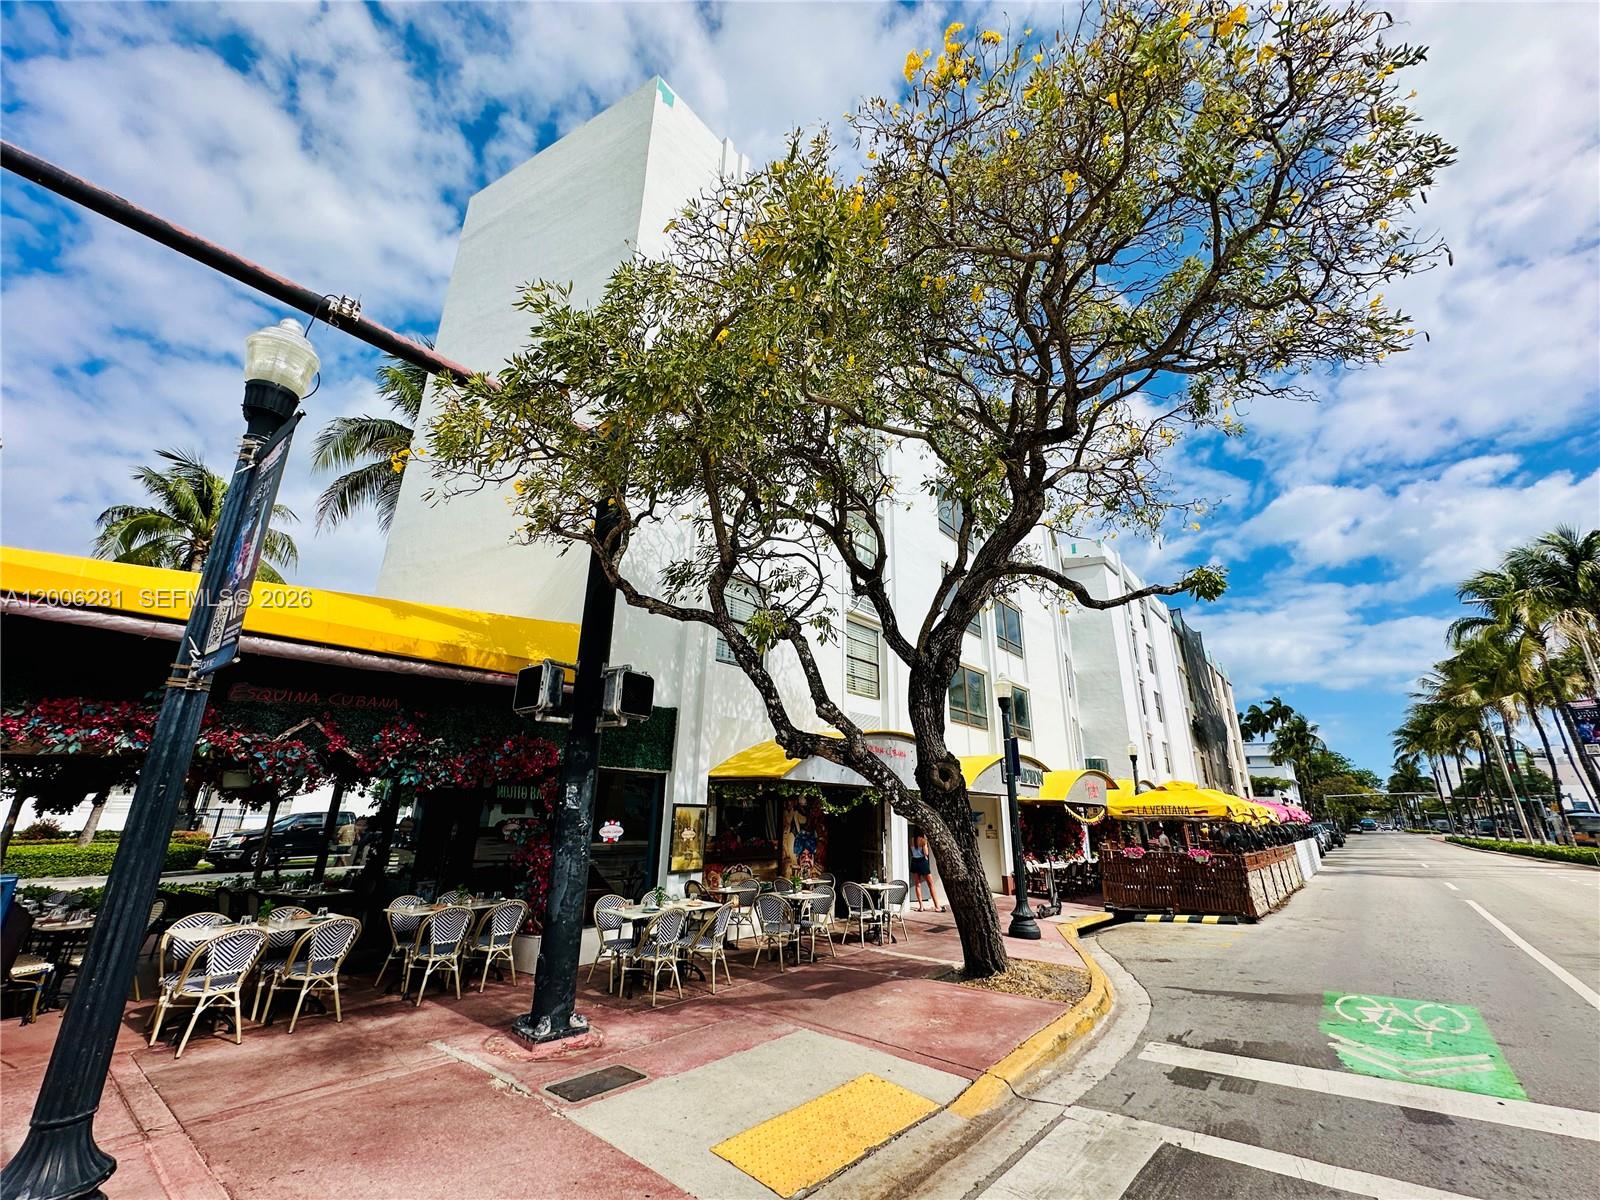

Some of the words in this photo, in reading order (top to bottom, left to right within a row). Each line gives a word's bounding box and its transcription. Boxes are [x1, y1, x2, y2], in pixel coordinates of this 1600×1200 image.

[328, 693, 400, 710] CUBANA
[530, 786, 545, 800] BA
[1136, 805, 1148, 815] LA
[1149, 805, 1191, 815] VENTANA
